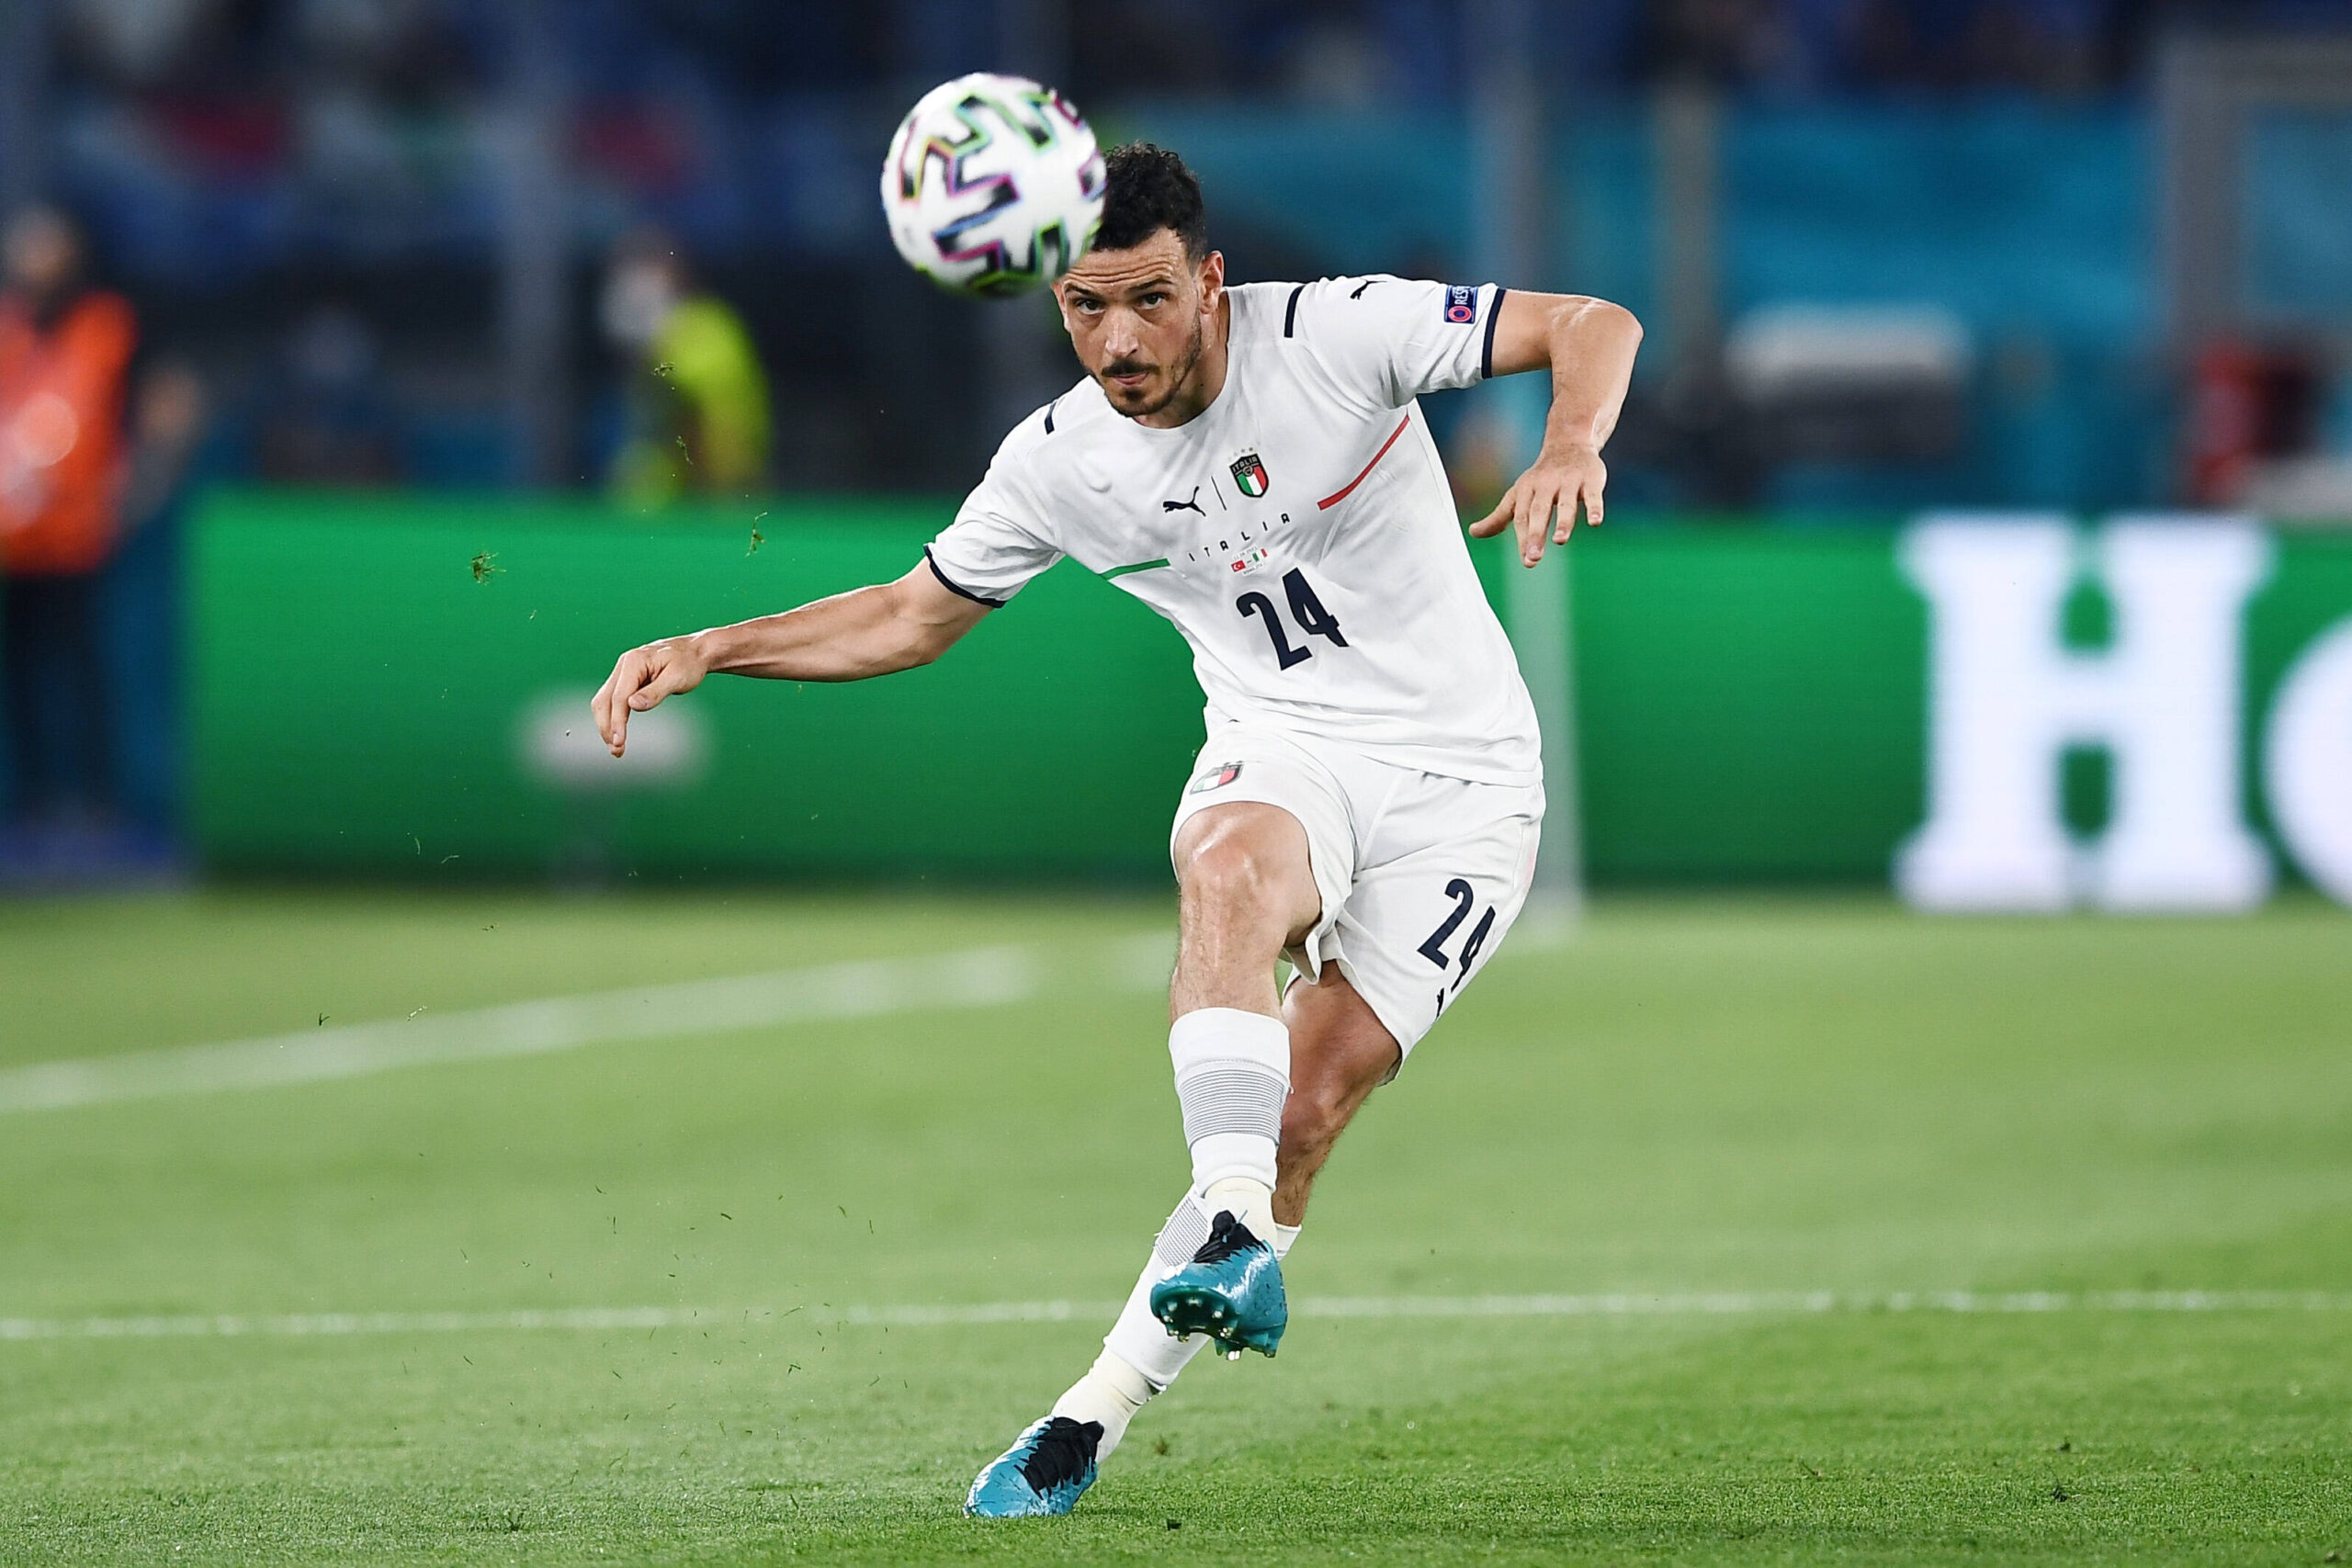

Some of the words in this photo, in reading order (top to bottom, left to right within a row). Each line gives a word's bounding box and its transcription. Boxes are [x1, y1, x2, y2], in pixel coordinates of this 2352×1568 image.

[1232, 456, 1259, 472] ITALIA
[1188, 513, 1291, 562] ITALIA
[1235, 567, 1350, 671] 24
[1417, 878, 1496, 993] 24
